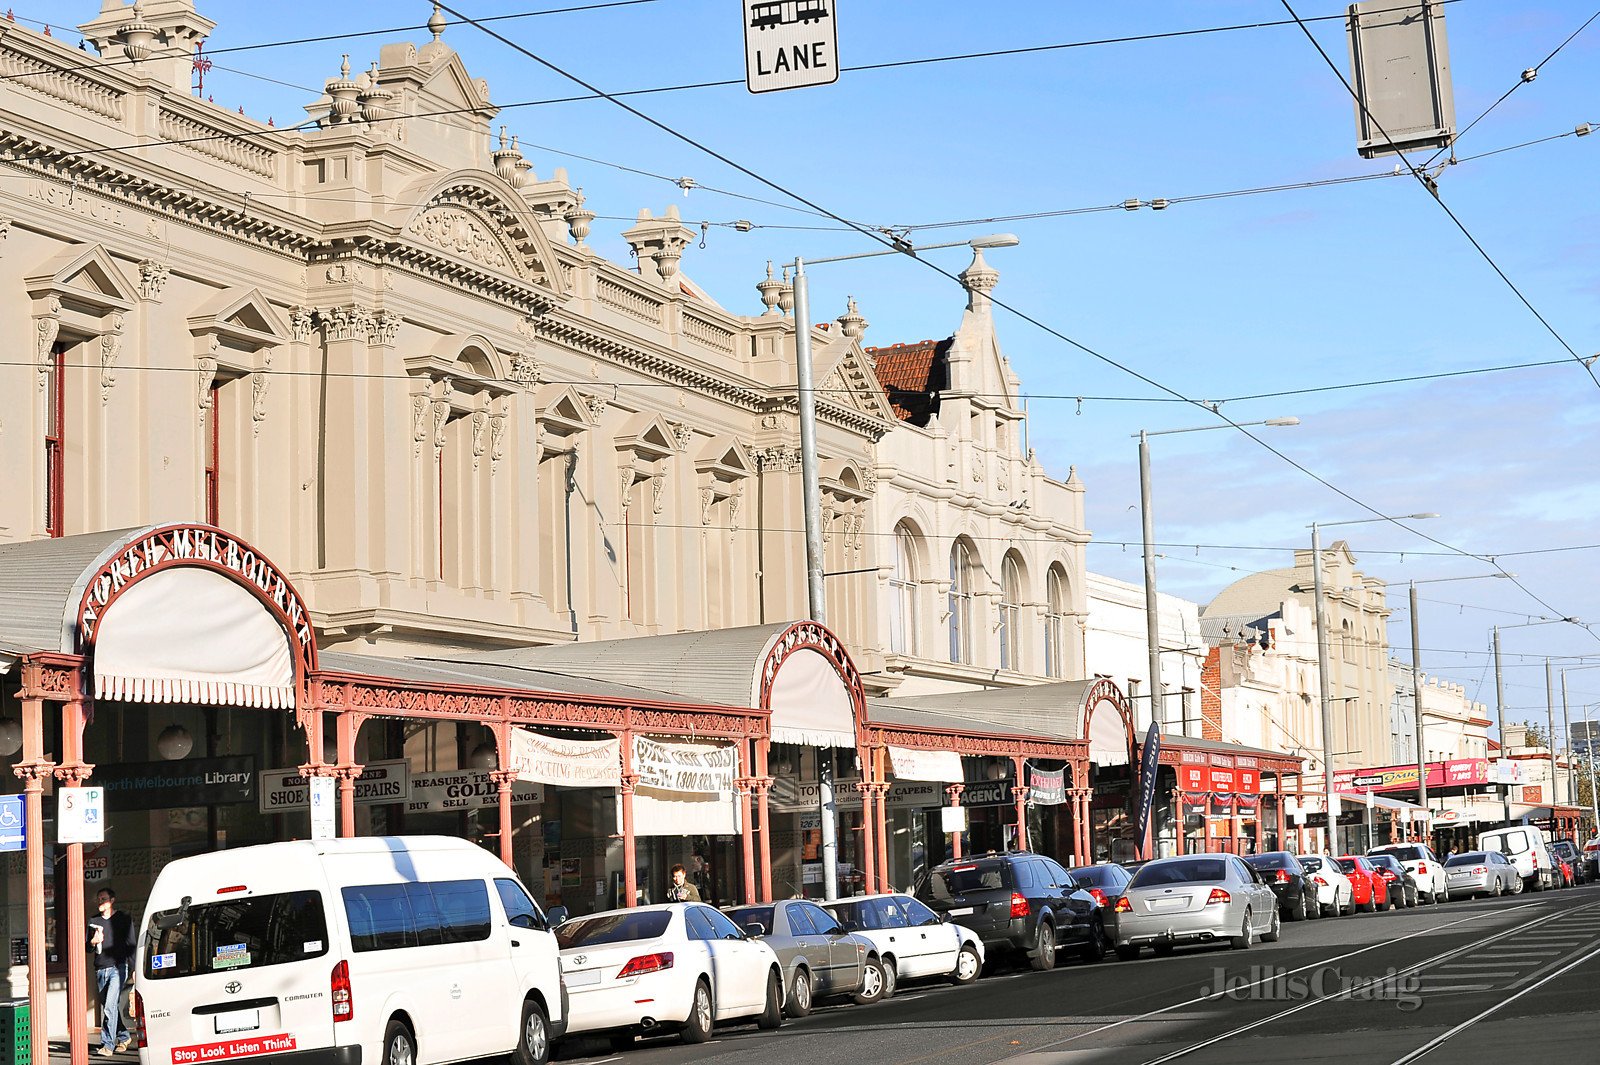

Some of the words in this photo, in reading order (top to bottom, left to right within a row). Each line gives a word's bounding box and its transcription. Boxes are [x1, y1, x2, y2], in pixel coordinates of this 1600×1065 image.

[757, 41, 827, 76] LANE
[82, 535, 160, 640] NORTH
[173, 528, 311, 646] MELBOURNE
[135, 774, 203, 790] Melbourne
[205, 771, 251, 785] Library
[86, 790, 99, 803] 1P
[270, 789, 304, 805] SHOE
[447, 782, 499, 799] GOLD
[895, 786, 933, 796] CAPERS
[409, 802, 430, 811] BUY
[443, 799, 469, 808] SELL
[85, 869, 103, 880] CUT
[284, 992, 323, 1002] COMMUTER
[174, 1049, 198, 1062] Stop
[201, 1045, 225, 1058] Look
[229, 1040, 259, 1054] Listen
[262, 1037, 293, 1051] Think
